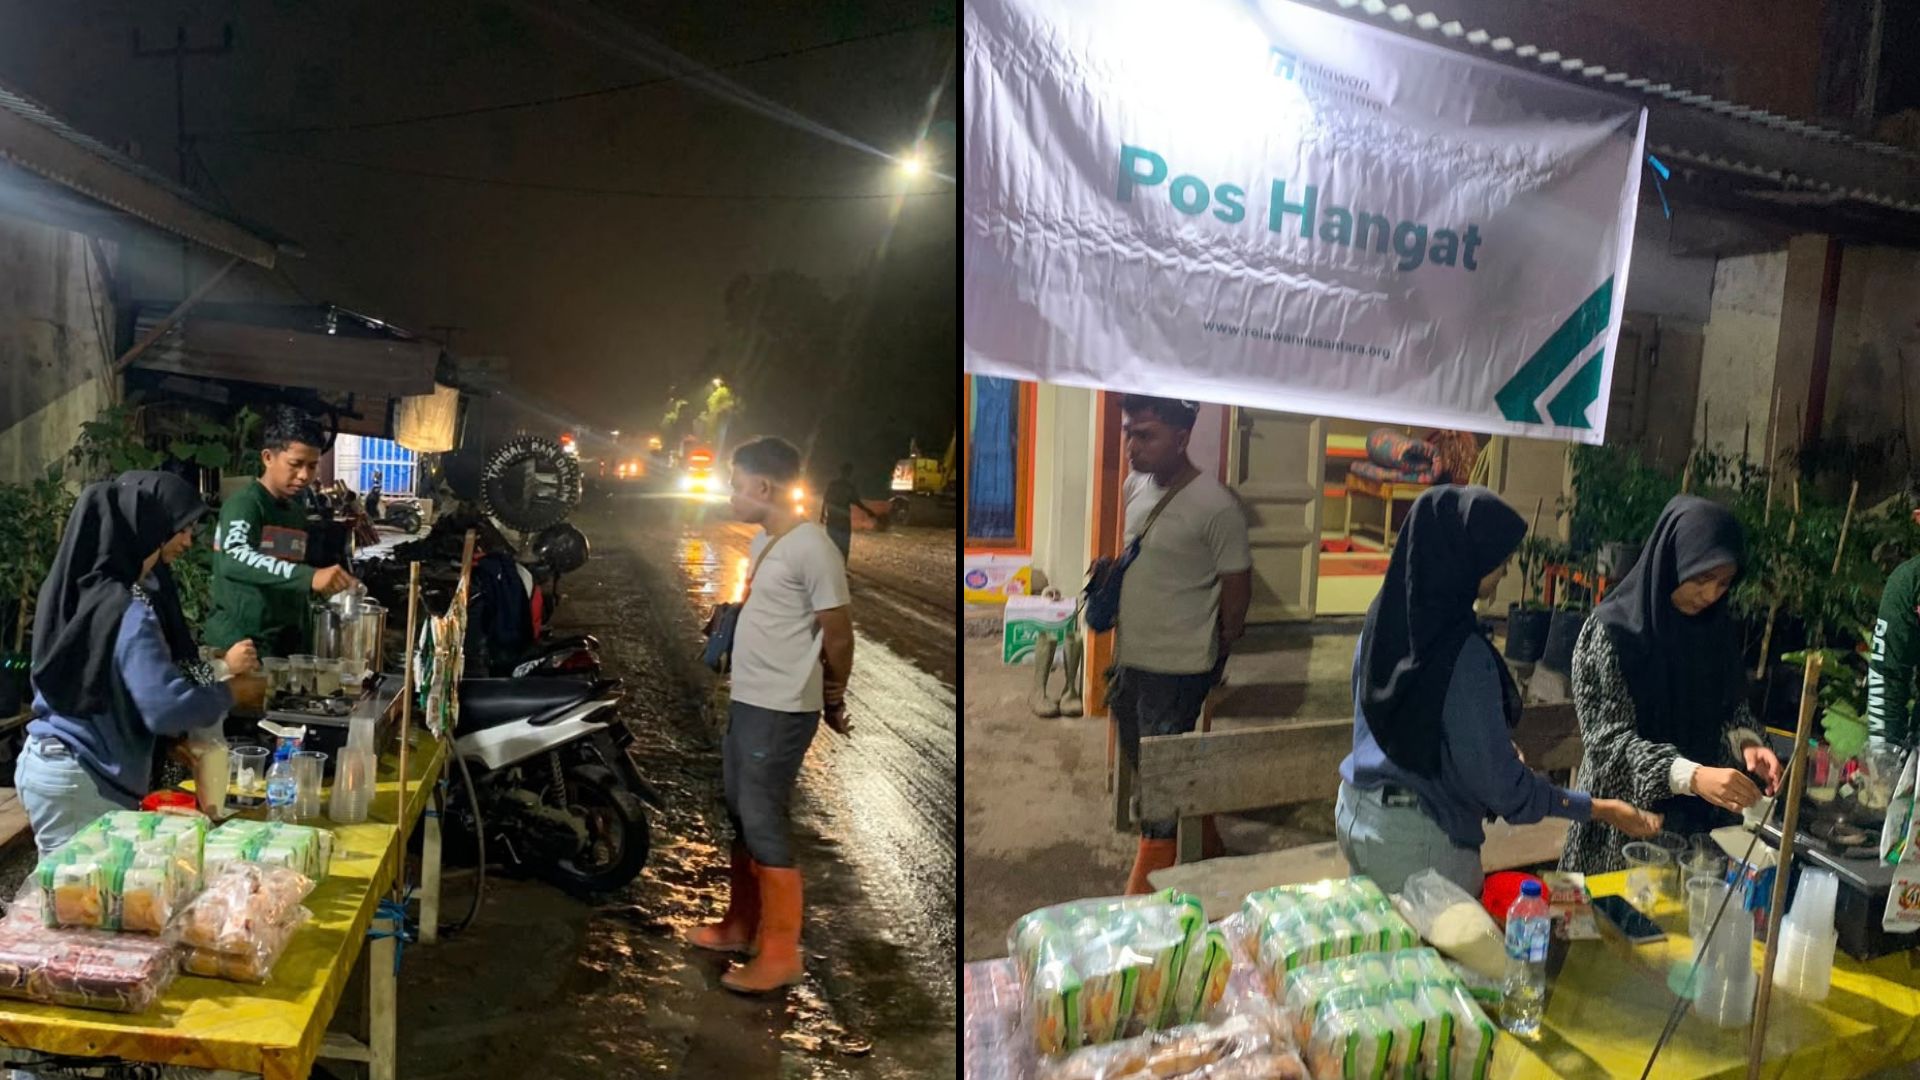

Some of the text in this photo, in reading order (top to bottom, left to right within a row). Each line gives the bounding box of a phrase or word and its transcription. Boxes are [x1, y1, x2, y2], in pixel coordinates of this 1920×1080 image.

[1116, 143, 1482, 272] Pos Hangat
[1203, 320, 1391, 361] www.relawannusantara.org
[487, 444, 526, 480] TAMBAL
[531, 442, 557, 458] BAN
